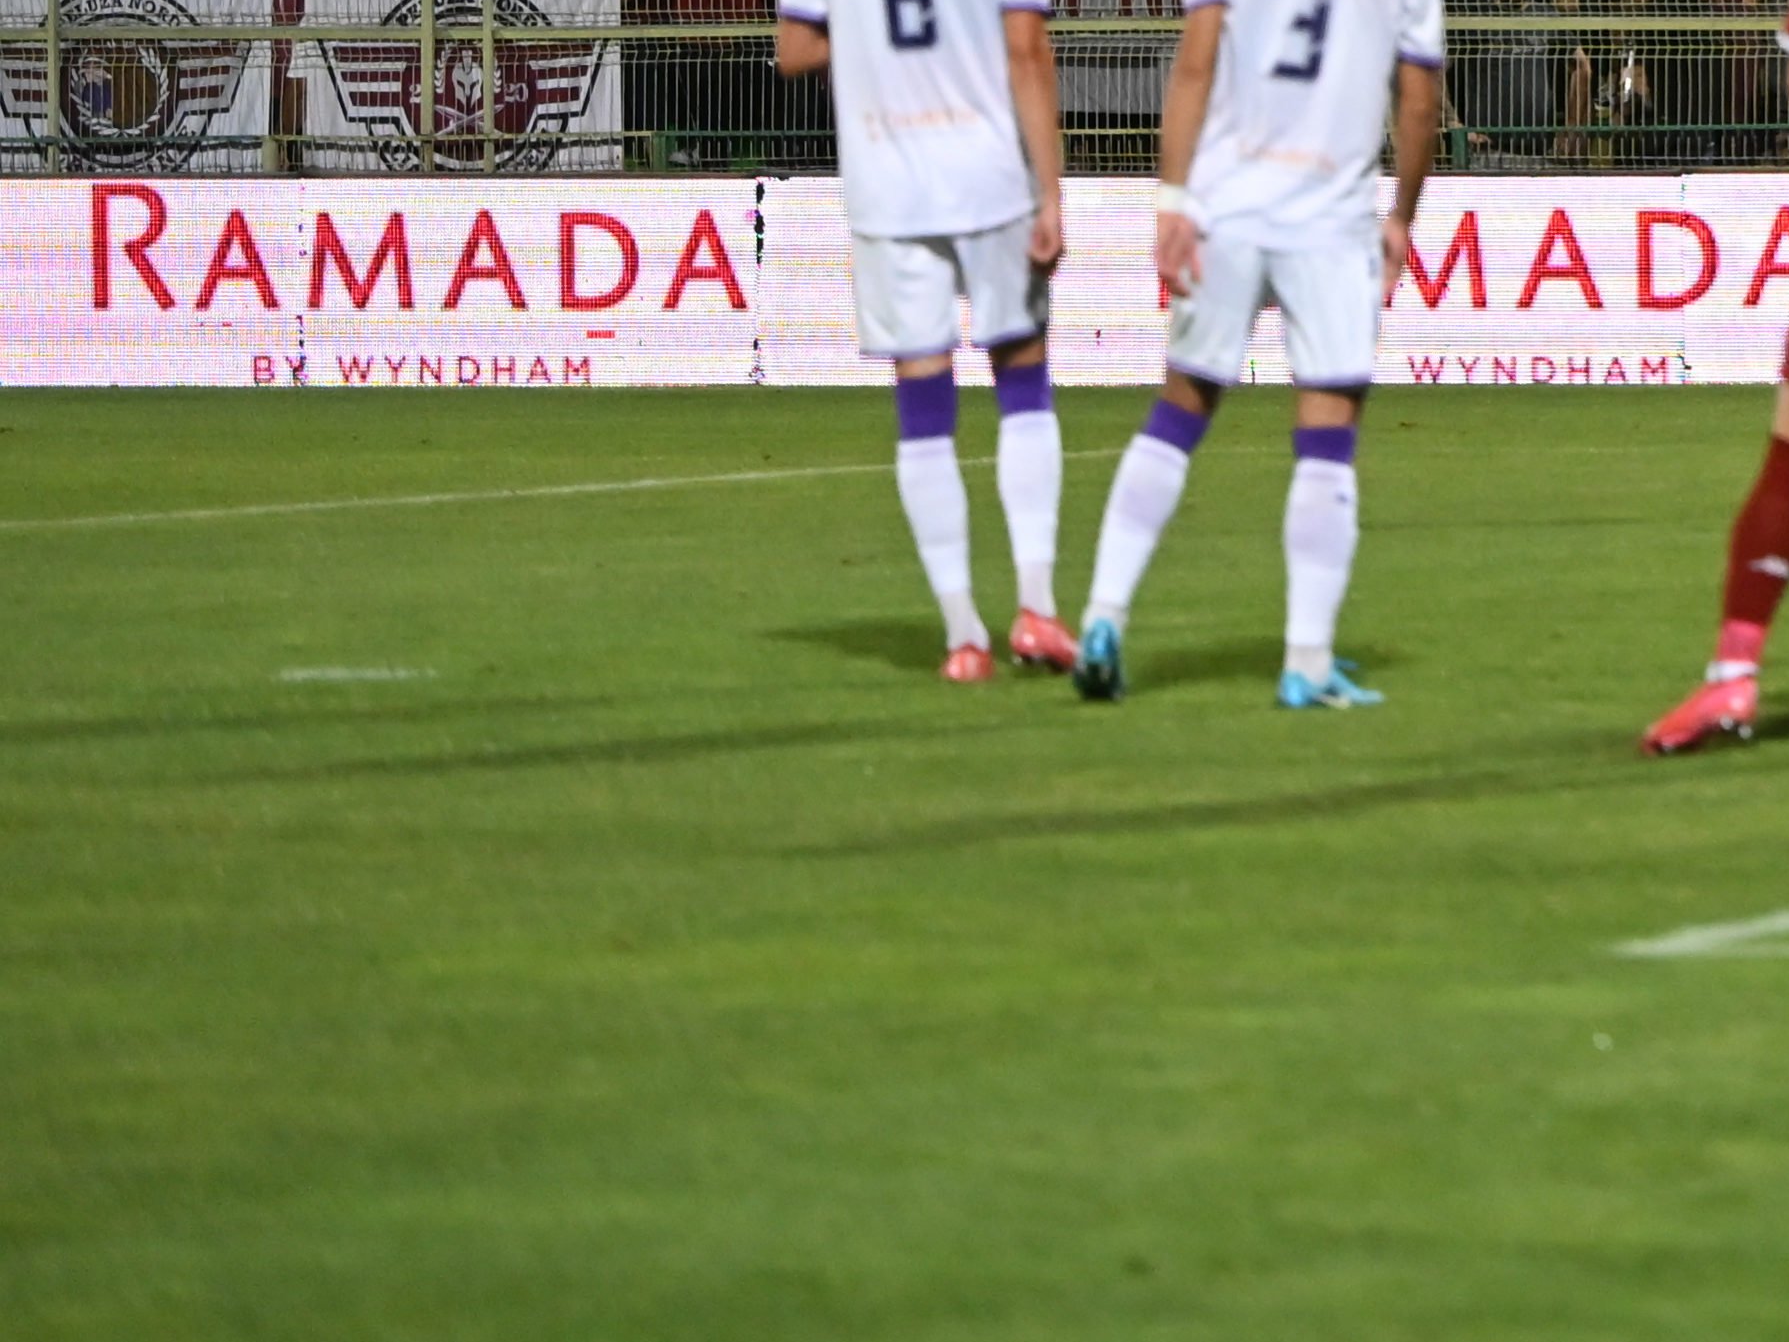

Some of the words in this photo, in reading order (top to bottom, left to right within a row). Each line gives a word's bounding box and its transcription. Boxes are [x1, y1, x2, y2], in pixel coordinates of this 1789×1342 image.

[91, 183, 746, 311] RAMADA
[254, 355, 306, 385] BY
[337, 355, 592, 385] WYNDHAM
[1408, 354, 1670, 385] WYNDHAM
